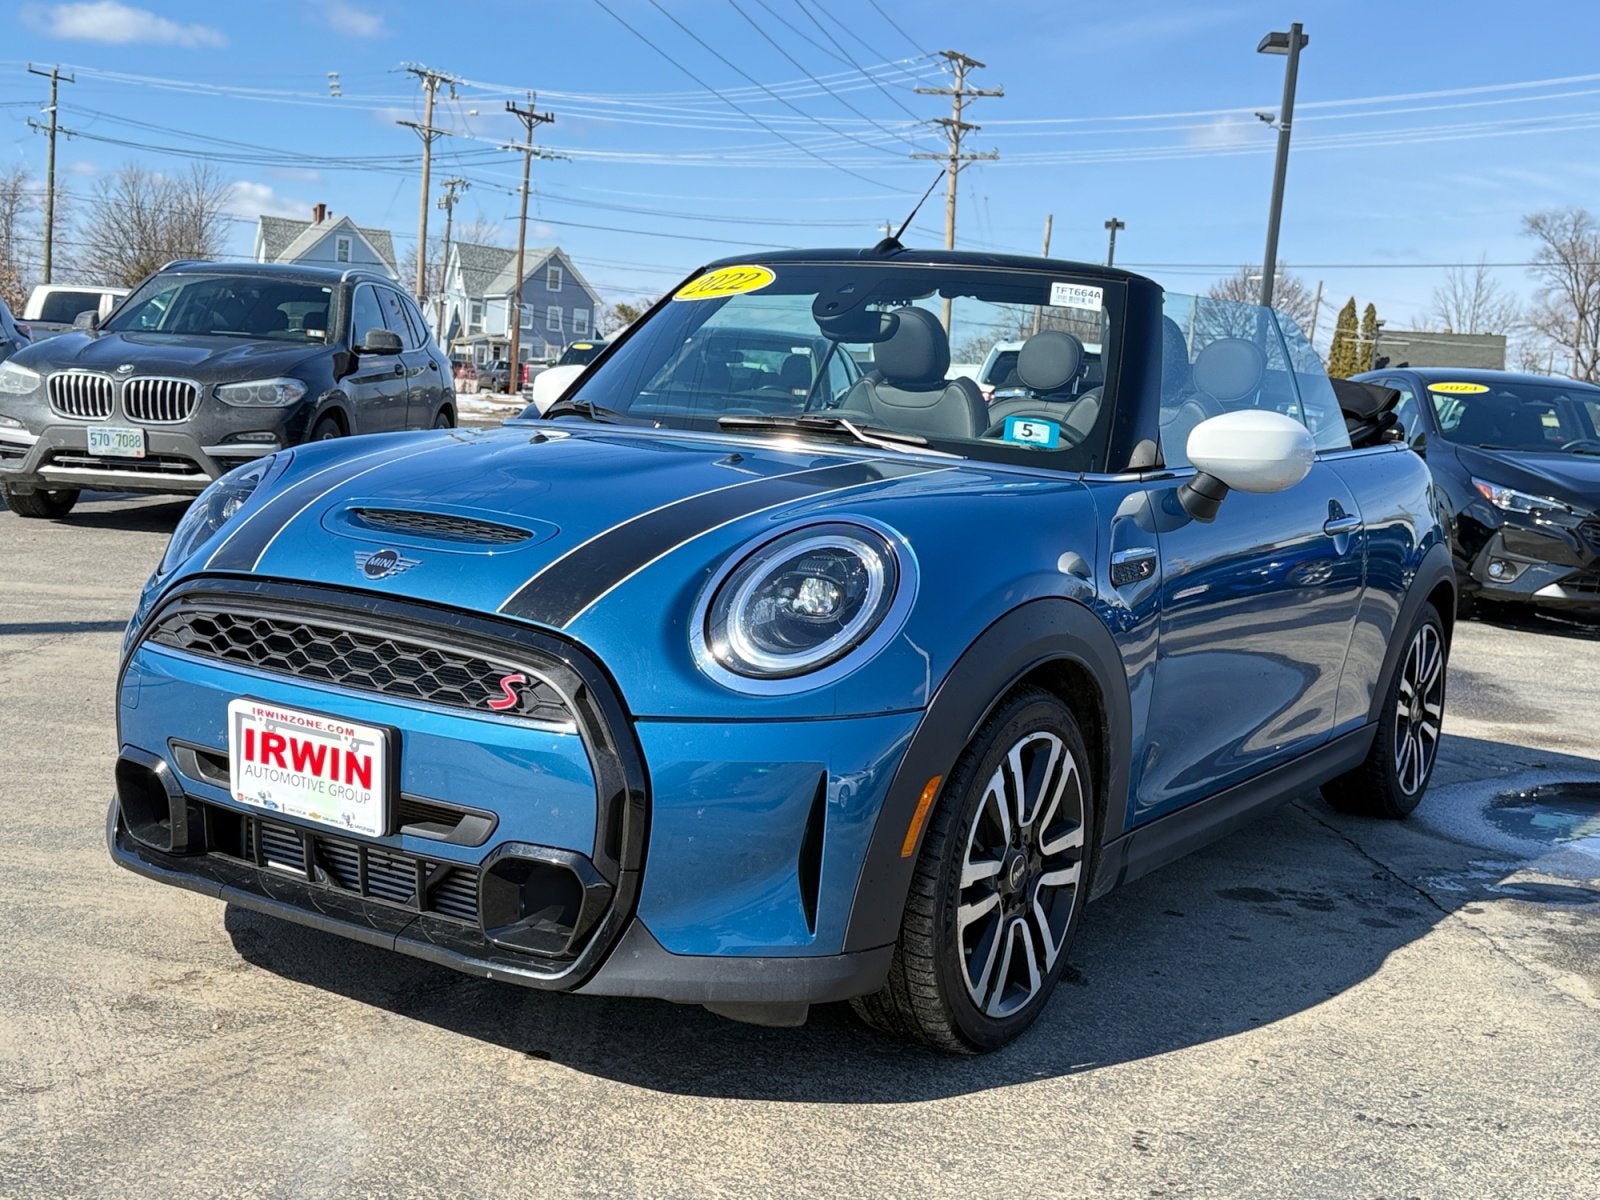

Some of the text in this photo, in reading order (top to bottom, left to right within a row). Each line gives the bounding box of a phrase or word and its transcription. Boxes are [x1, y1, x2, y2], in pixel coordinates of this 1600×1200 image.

[681, 272, 761, 296] 2022
[1055, 286, 1101, 299] TFT664A
[1021, 423, 1033, 437] 5
[367, 557, 394, 568] MINI
[486, 674, 527, 710] S
[253, 707, 355, 736] IRWINZONE.COM
[244, 728, 372, 790] IRWIN
[244, 764, 371, 805] AUTOMOTIVE GROUP
